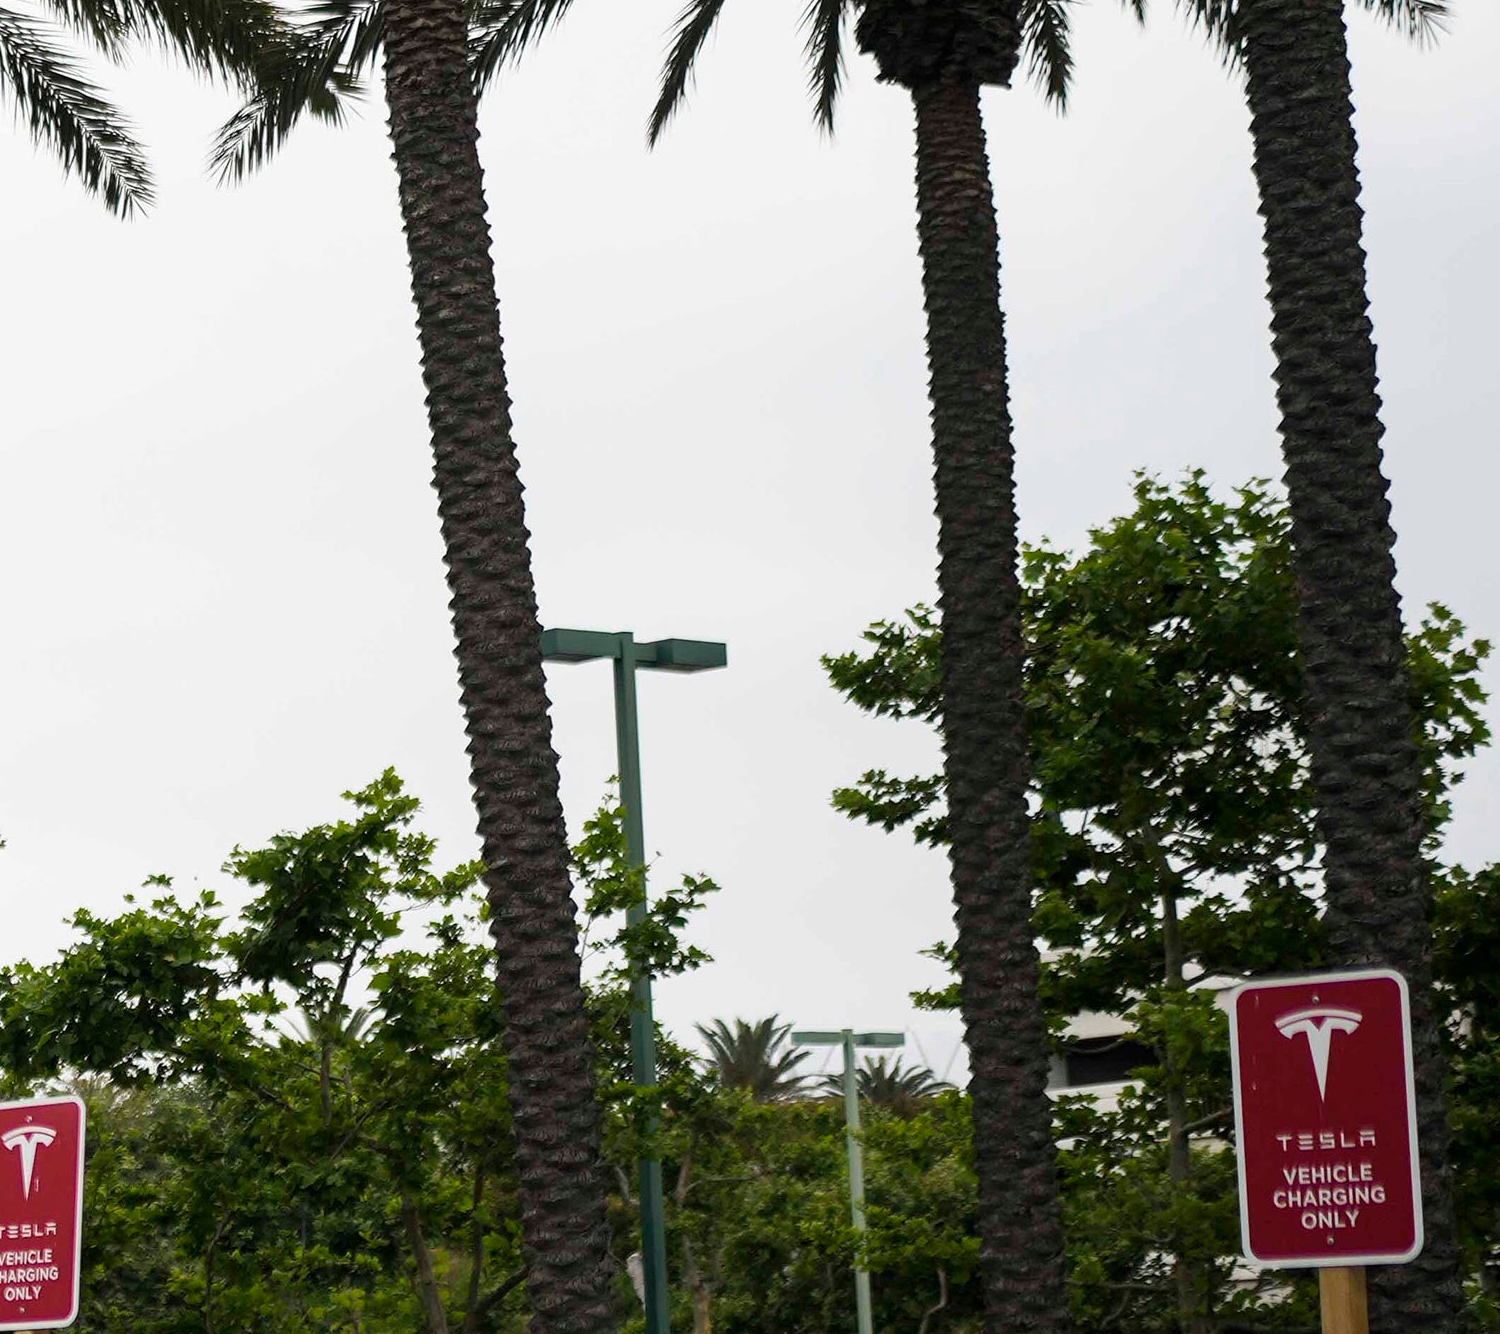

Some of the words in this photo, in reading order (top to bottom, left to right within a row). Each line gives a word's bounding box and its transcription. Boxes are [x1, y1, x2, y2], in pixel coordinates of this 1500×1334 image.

[1276, 1129, 1377, 1152] TESLA
[1283, 1163, 1373, 1185] VEHICLE
[1273, 1185, 1386, 1209] CHARGING
[1301, 1209, 1360, 1230] ONLY
[4, 1285, 43, 1302] ONLY
